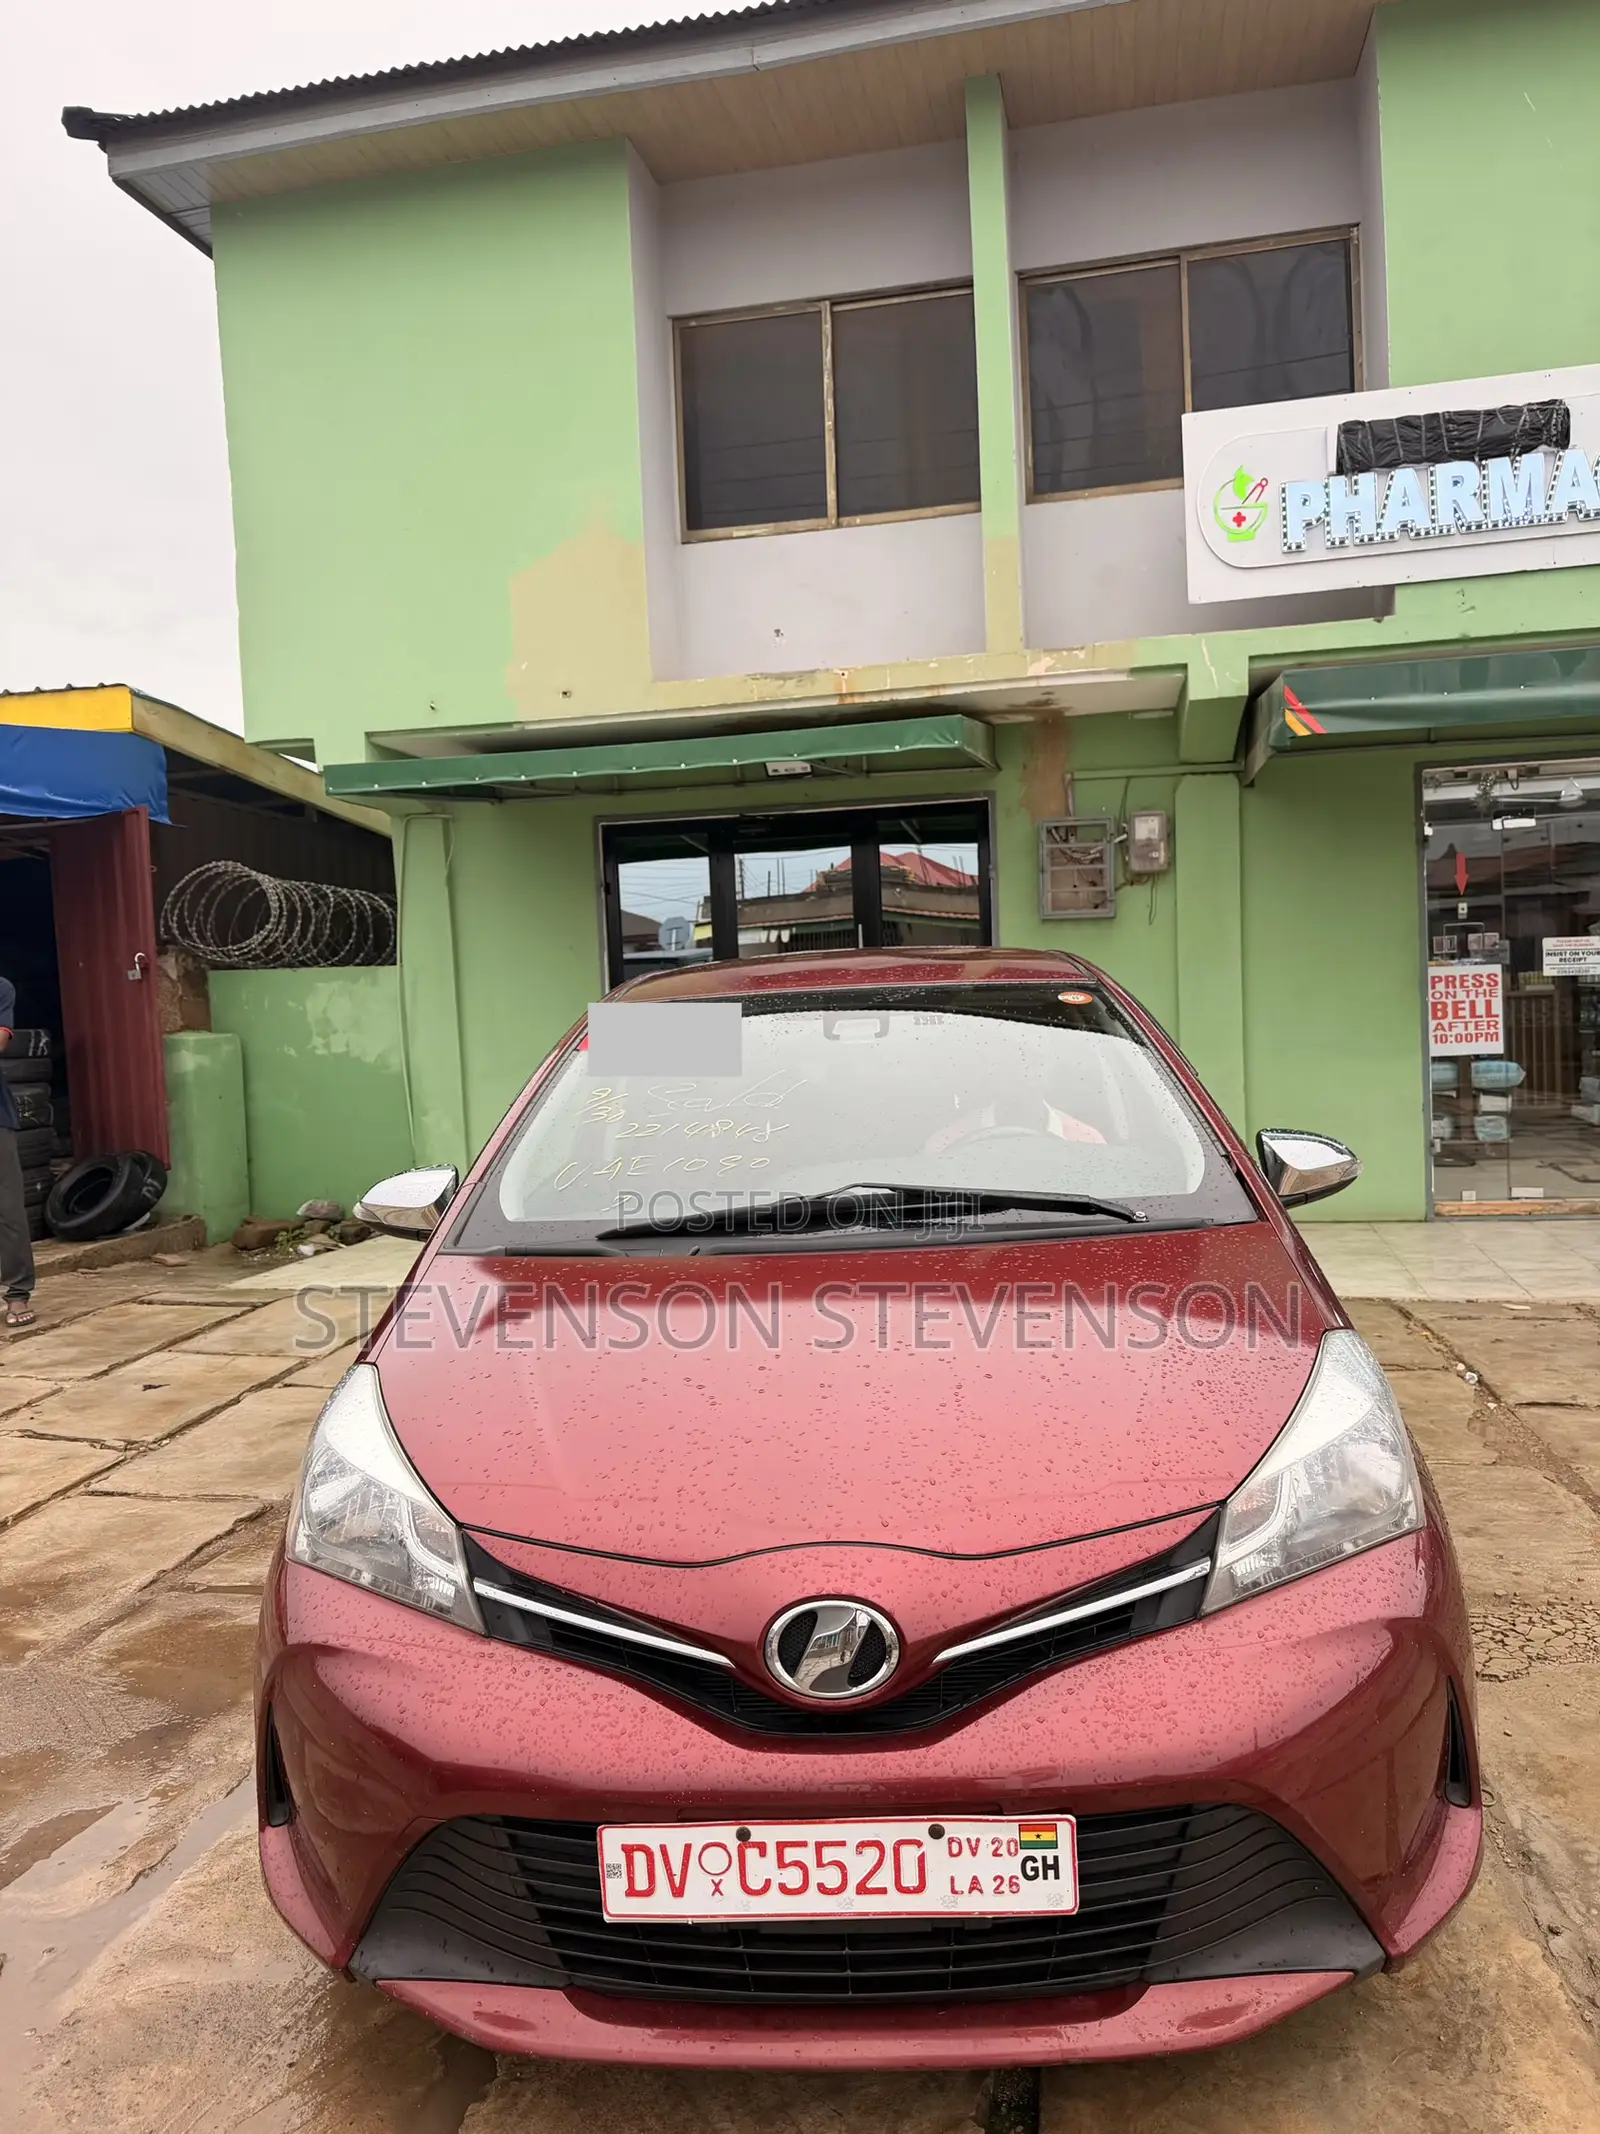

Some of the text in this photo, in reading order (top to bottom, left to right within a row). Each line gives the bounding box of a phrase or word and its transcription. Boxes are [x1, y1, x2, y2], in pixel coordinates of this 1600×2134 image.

[1280, 446, 1600, 553] PHARMA
[1430, 973, 1499, 990] PRESS
[1431, 988, 1499, 1000] ON THE
[1431, 999, 1500, 1020] BELL
[1433, 1019, 1499, 1032] AFTER
[1432, 1031, 1500, 1044] 10:00PM
[947, 1836, 1019, 1858] DV 20
[737, 1836, 927, 1897] C5520
[1020, 1855, 1061, 1881] GH
[950, 1875, 1021, 1895] LA 26
